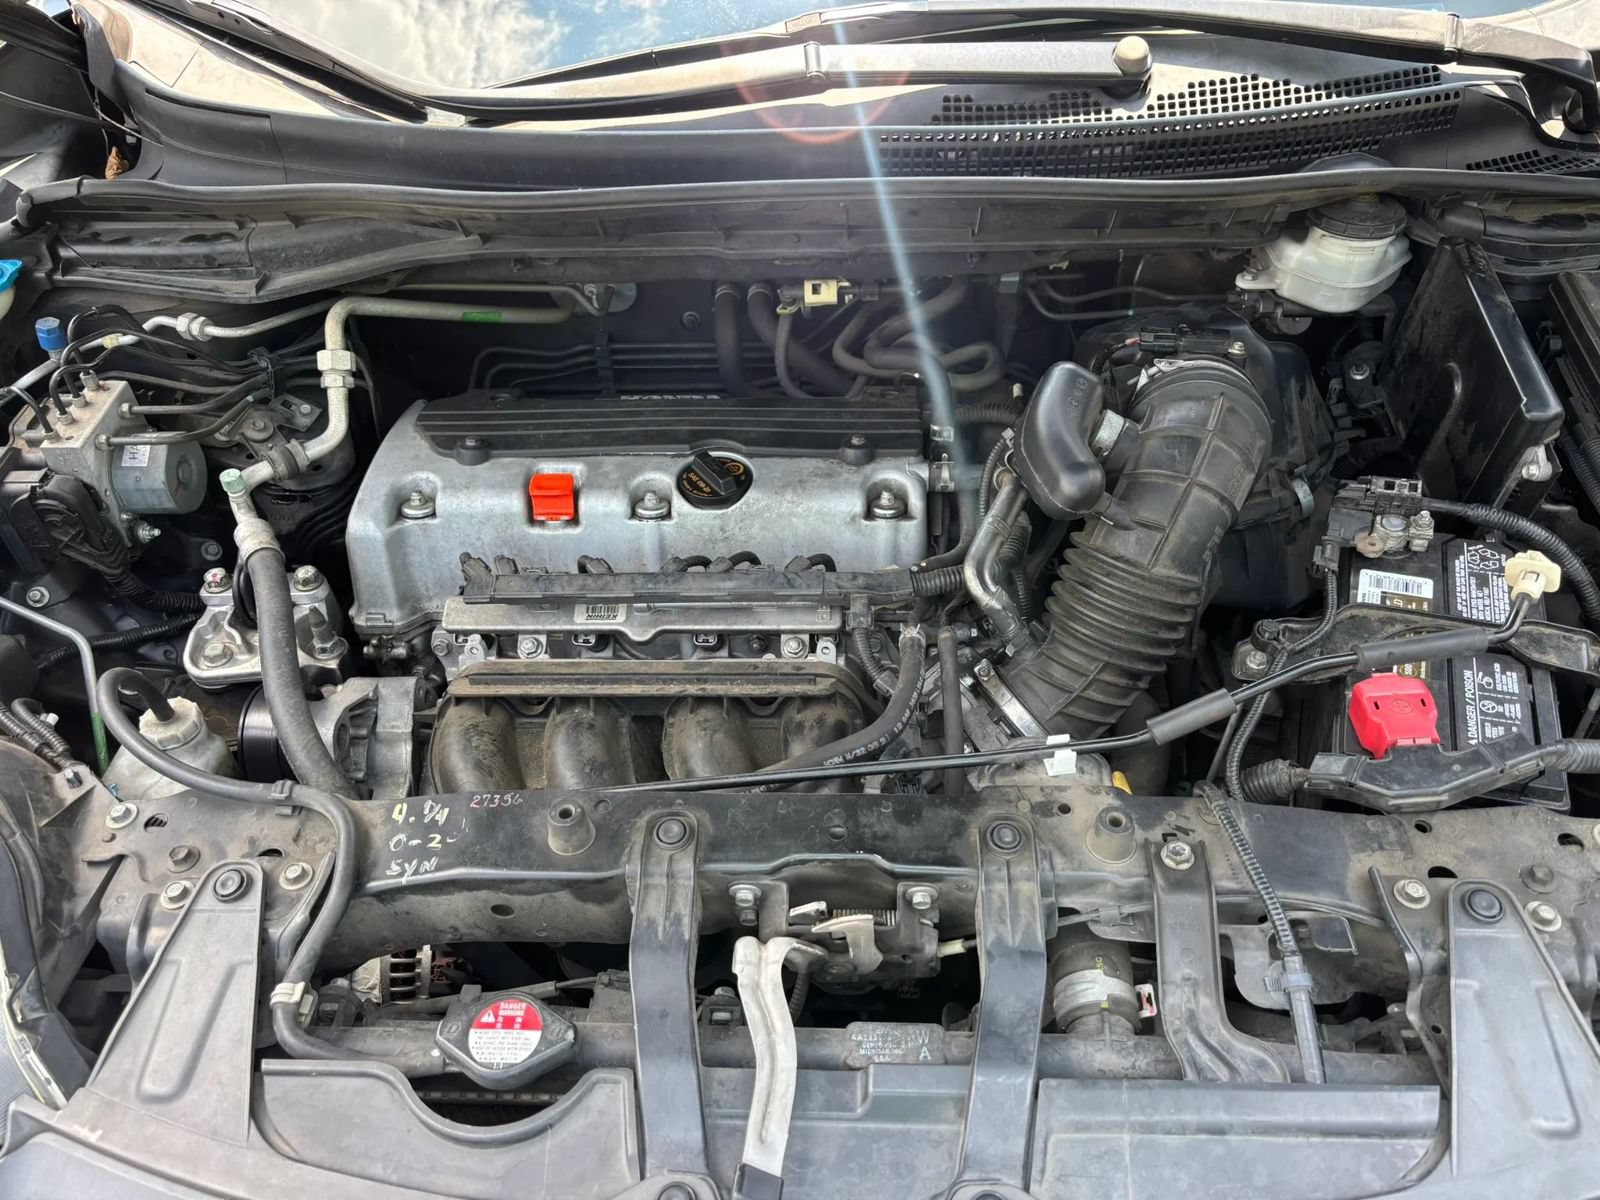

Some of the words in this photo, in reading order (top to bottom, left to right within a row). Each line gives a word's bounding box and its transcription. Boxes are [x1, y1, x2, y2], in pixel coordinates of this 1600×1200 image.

[1404, 663, 1413, 676] 500
[1463, 670, 1474, 698] POISON
[1465, 704, 1478, 738] DANGER
[385, 856, 438, 885] SYN
[919, 1046, 931, 1061] A
